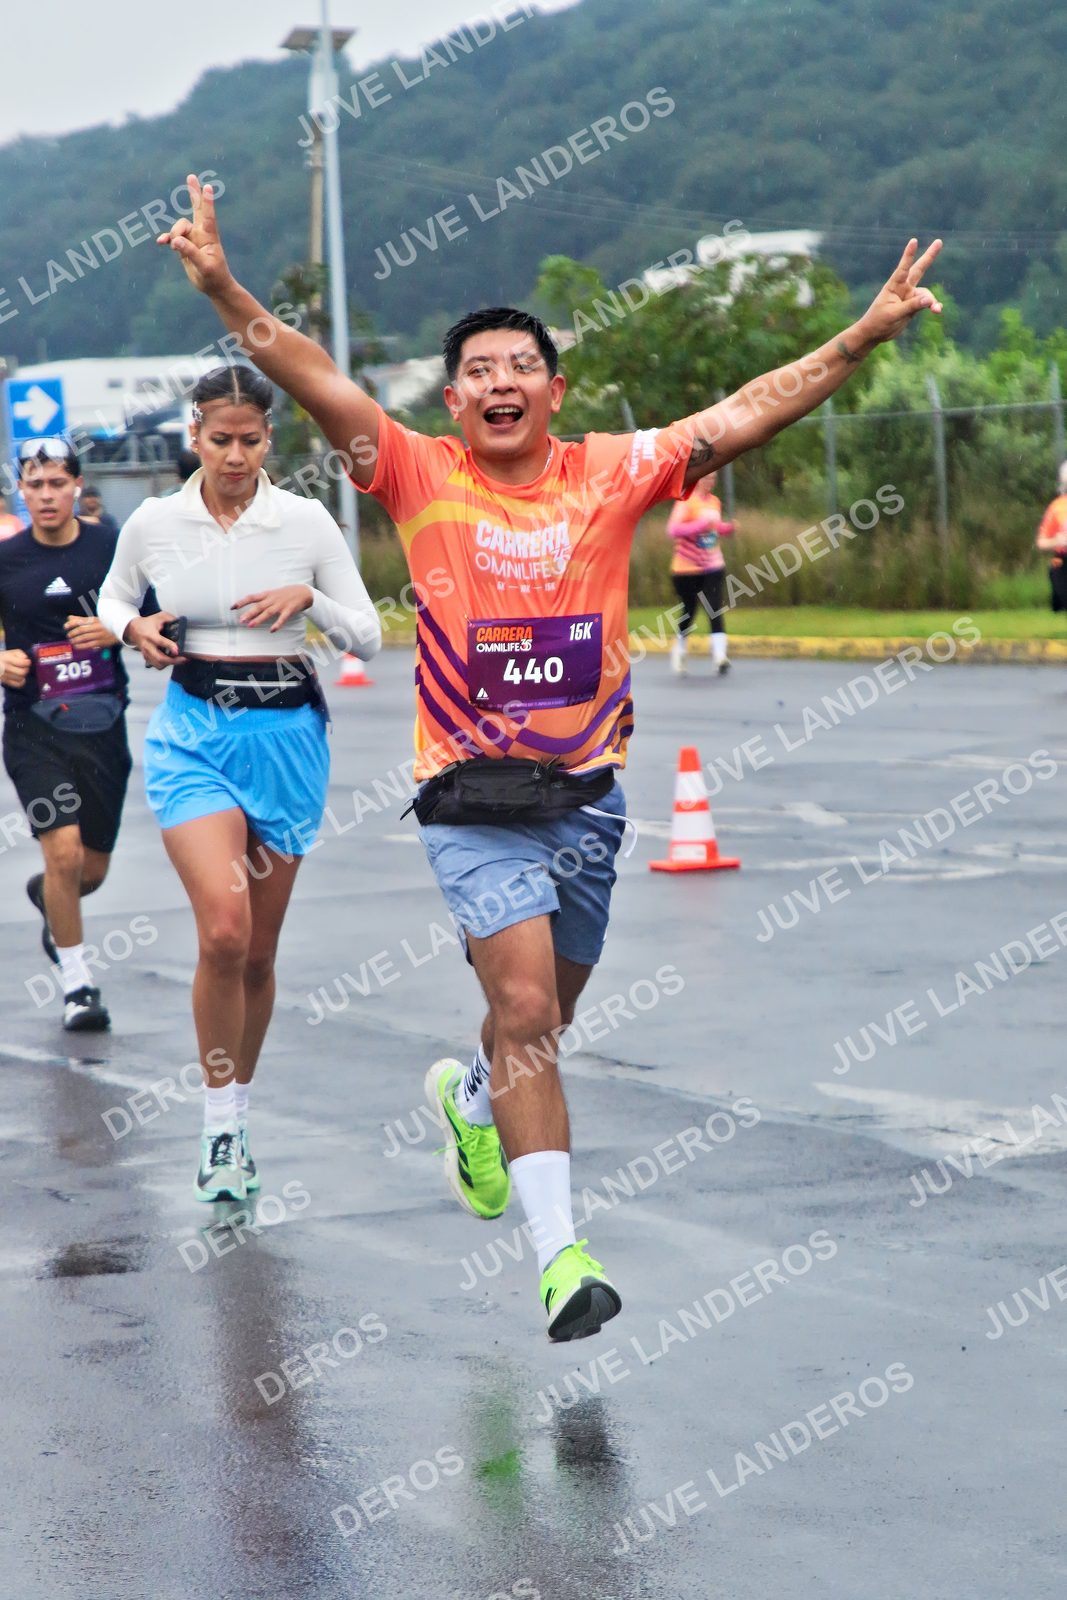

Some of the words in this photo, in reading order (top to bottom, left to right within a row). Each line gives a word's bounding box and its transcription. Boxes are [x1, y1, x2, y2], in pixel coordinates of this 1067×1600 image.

[476, 519, 570, 558] CARRERA
[476, 625, 533, 642] CARRERA
[569, 621, 594, 641] 15K
[55, 659, 93, 682] 205
[503, 656, 564, 685] 440
